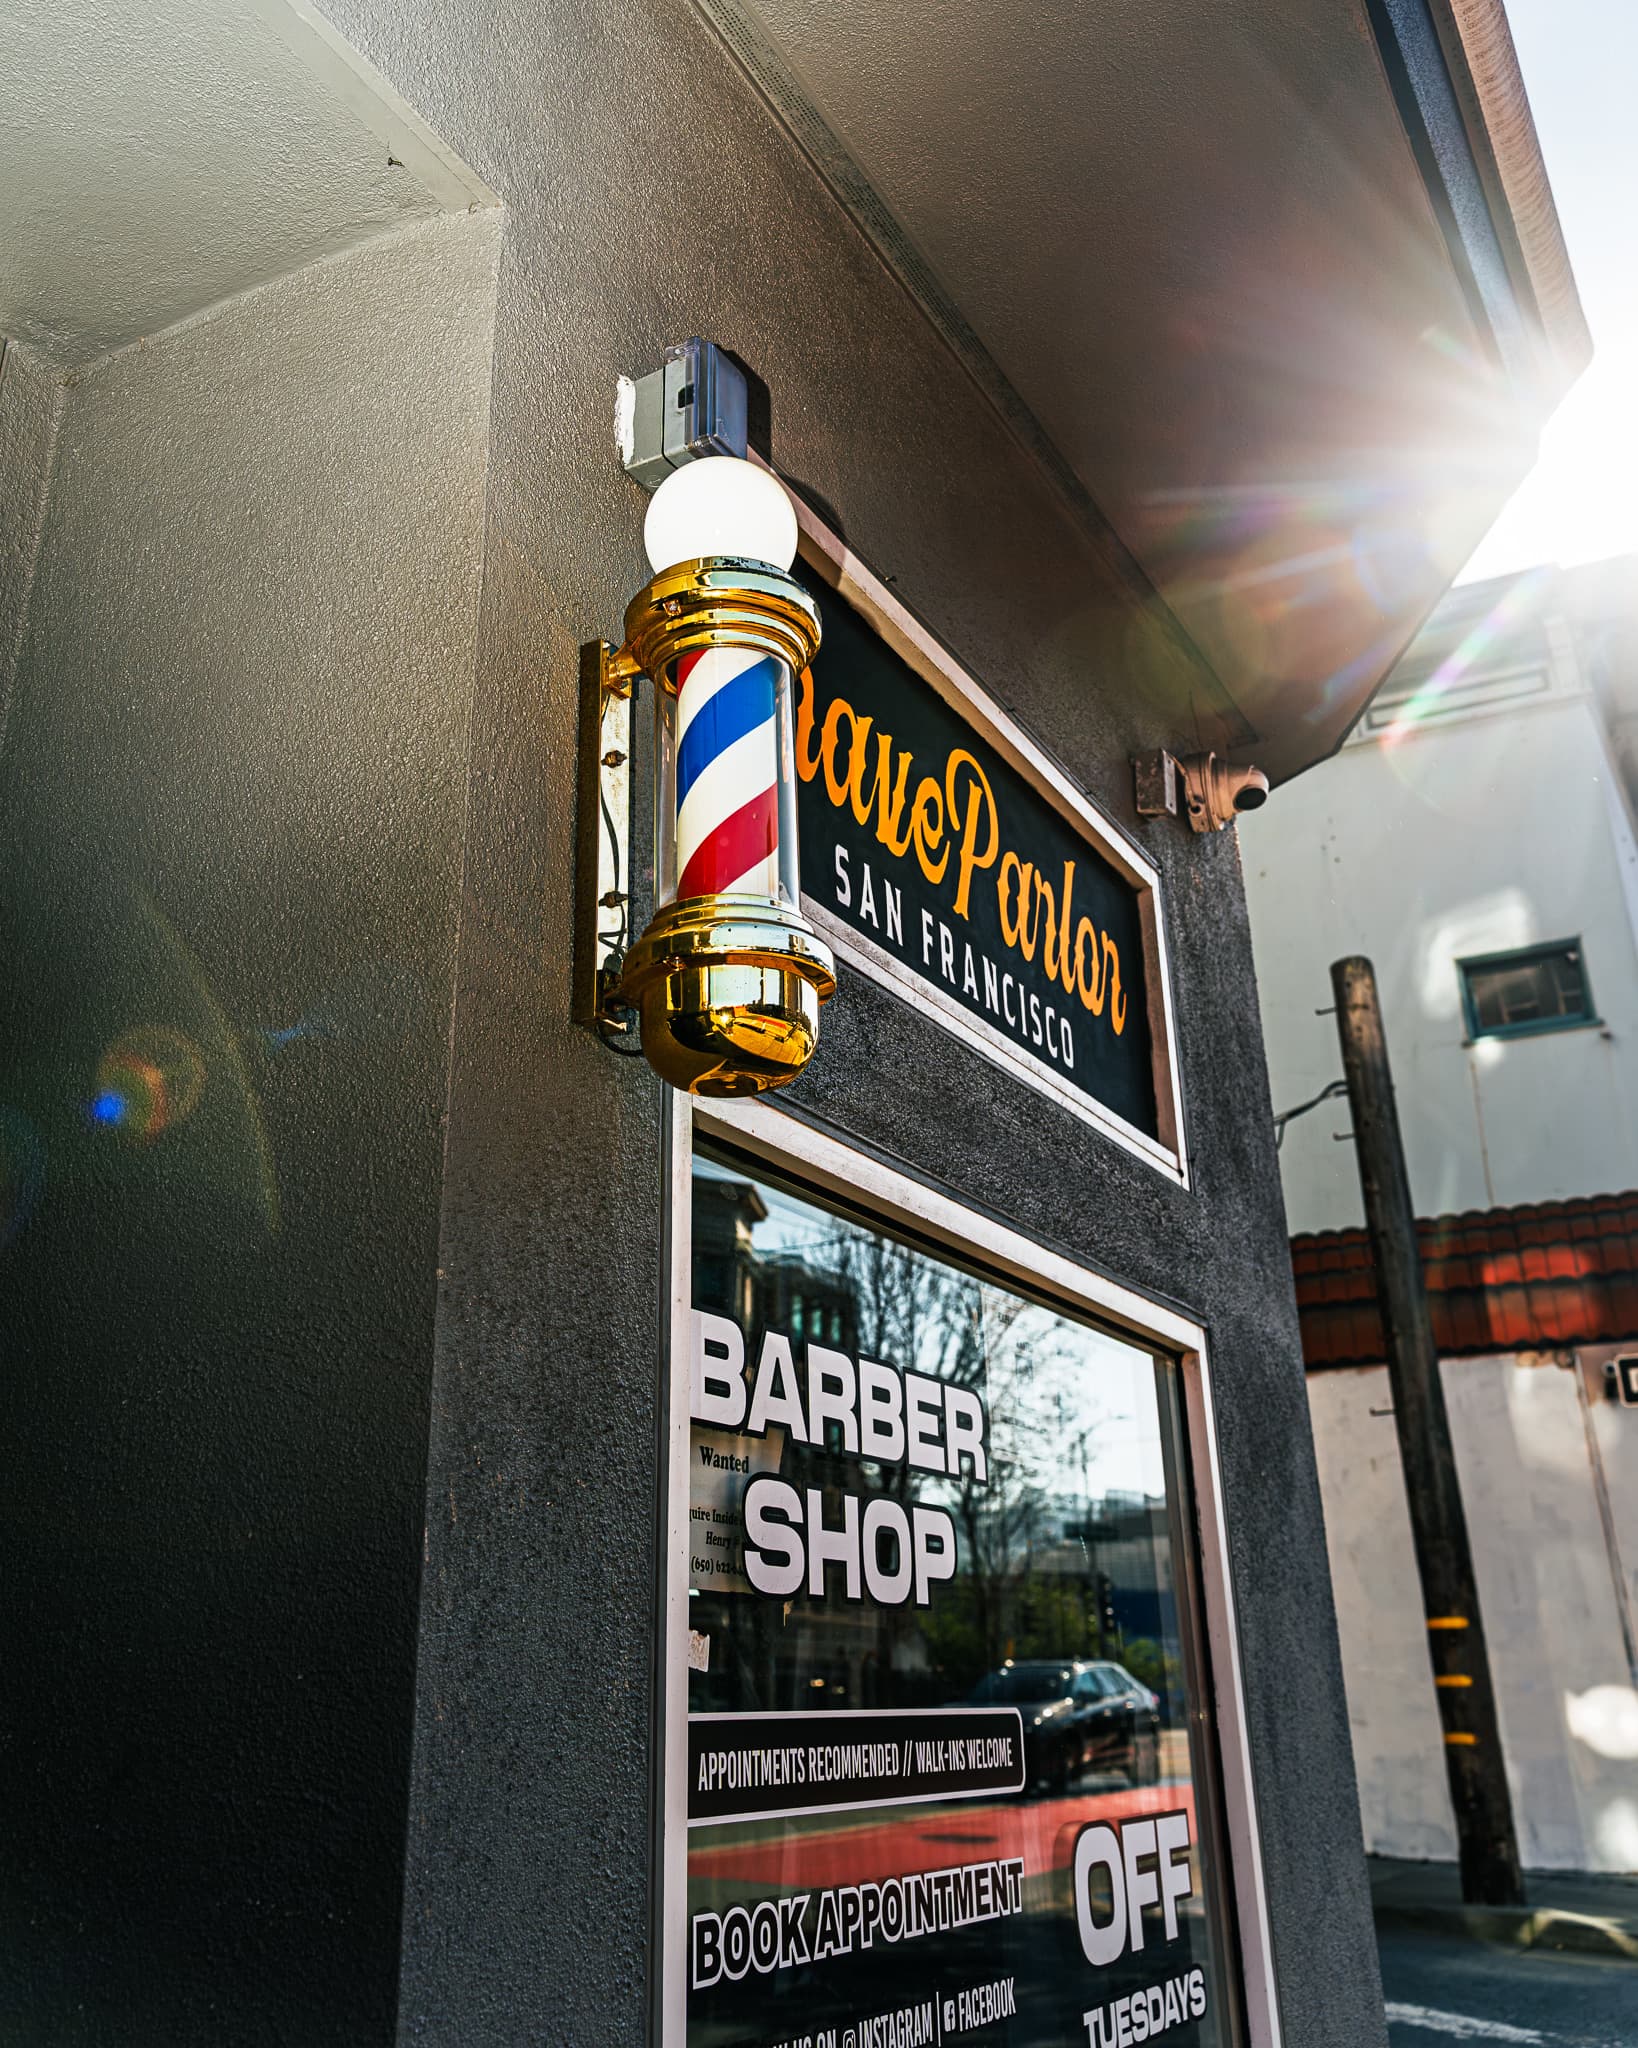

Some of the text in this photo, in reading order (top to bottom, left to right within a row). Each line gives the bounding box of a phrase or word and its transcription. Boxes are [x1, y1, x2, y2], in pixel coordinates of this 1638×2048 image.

[945, 748, 1127, 1037] Parlor
[835, 843, 1075, 1070] SAN FRANCISCO
[690, 1308, 988, 1482] BARBER
[699, 1445, 750, 1474] Wanted
[691, 1555, 714, 1576] (650)
[705, 1531, 731, 1550] Henry
[744, 1477, 957, 1606] SHOP
[698, 1748, 806, 1791] APPOINTMENTS
[808, 1743, 899, 1783] RECOMMENDED
[915, 1740, 966, 1774] WALK-INS
[966, 1737, 1014, 1769] WELCOME
[693, 1857, 1025, 1990] BOOK APPOINTMENT
[1074, 1813, 1193, 1966] OFF
[858, 2002, 934, 2048] INSTAGRAM
[957, 1977, 1017, 2032] FACEBOOK
[1083, 1968, 1207, 2048] TUESDAYS
